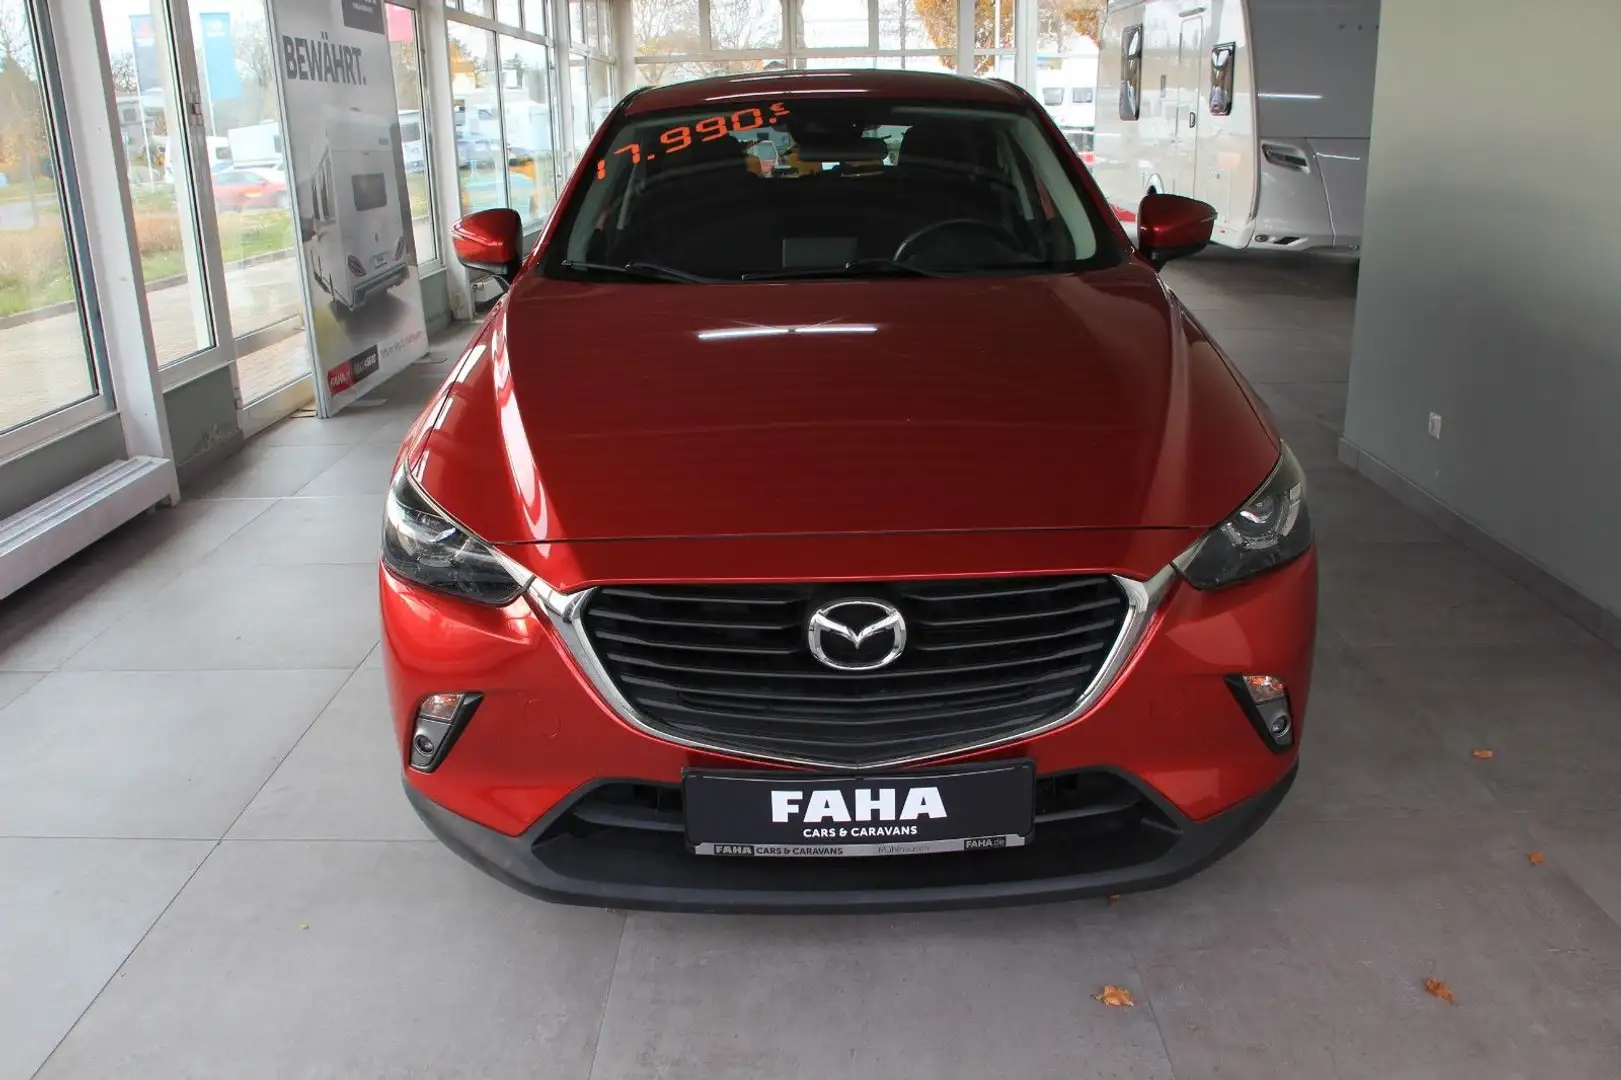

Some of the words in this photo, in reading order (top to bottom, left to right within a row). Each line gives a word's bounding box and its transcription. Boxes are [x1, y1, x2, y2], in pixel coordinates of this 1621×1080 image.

[282, 31, 367, 86] BEWÄHRT.
[771, 786, 948, 823] FAHA
[803, 827, 836, 838] CARS
[839, 827, 848, 837] &
[850, 825, 918, 837] CARAVANS
[715, 844, 752, 855] FAHA
[755, 847, 782, 855] CARS
[783, 847, 790, 855] &
[792, 847, 844, 855] CARAVANS
